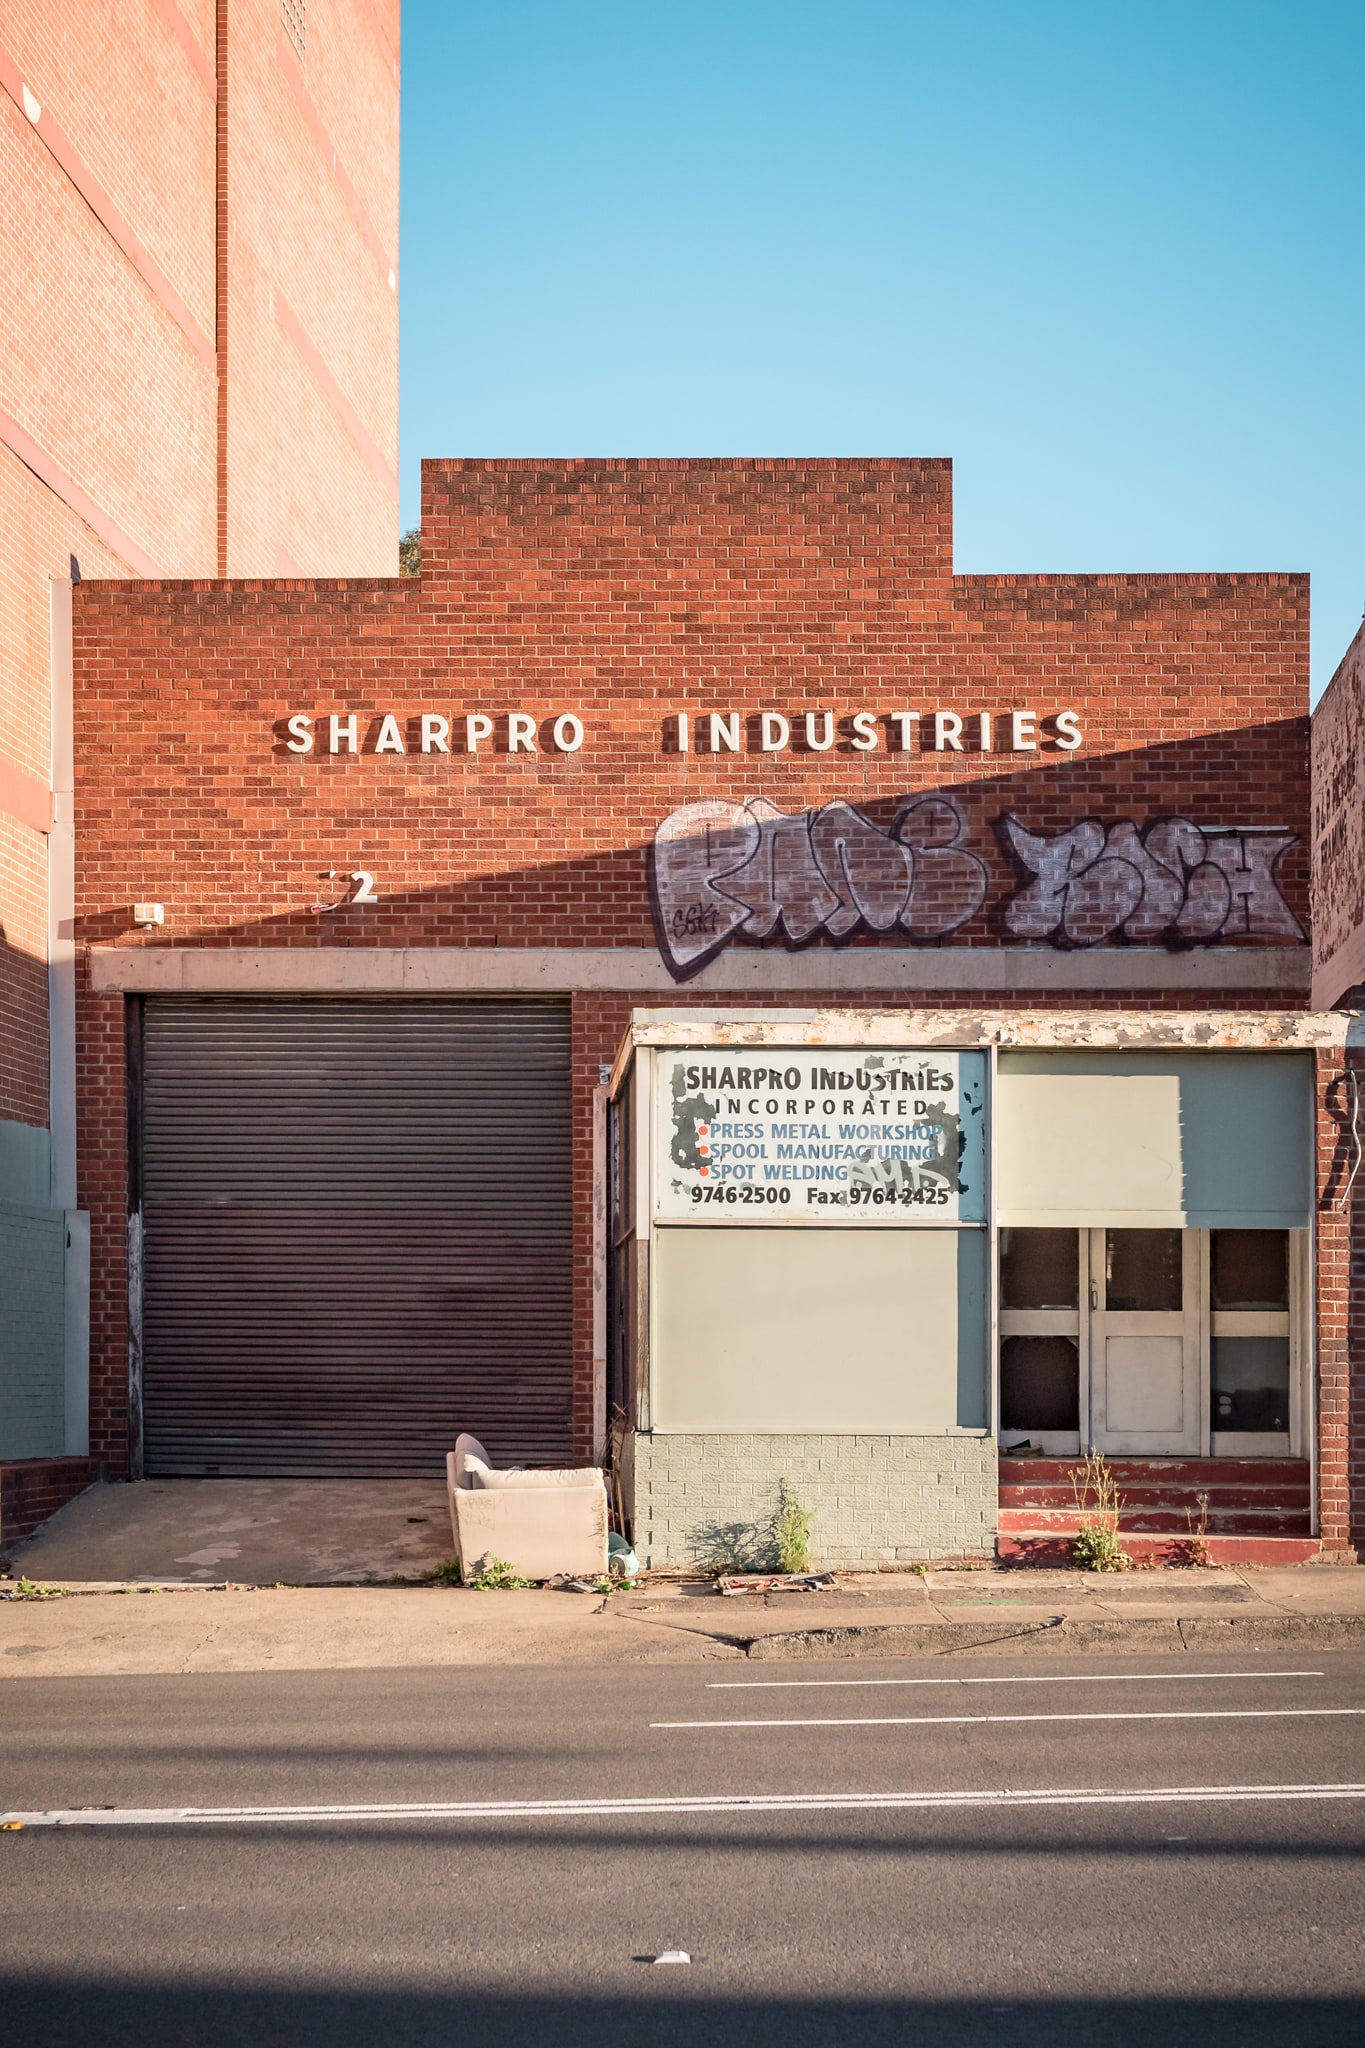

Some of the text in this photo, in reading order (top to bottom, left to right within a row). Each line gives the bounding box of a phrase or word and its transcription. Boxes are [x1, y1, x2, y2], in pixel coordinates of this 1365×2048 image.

[286, 711, 1083, 754] SHARPRO INDUSTRIES
[686, 1066, 954, 1092] SHARPRO INDUSTRIES
[715, 1099, 927, 1116] INCORPORATED
[710, 1123, 943, 1141] PRESS METAL WORKSHOP
[710, 1143, 936, 1161] SPOOL MANUFACTURING
[710, 1164, 756, 1180] SPOT
[764, 1165, 848, 1181] WELDING
[691, 1186, 949, 1205] 9746-2500 Fax 9764-2425
